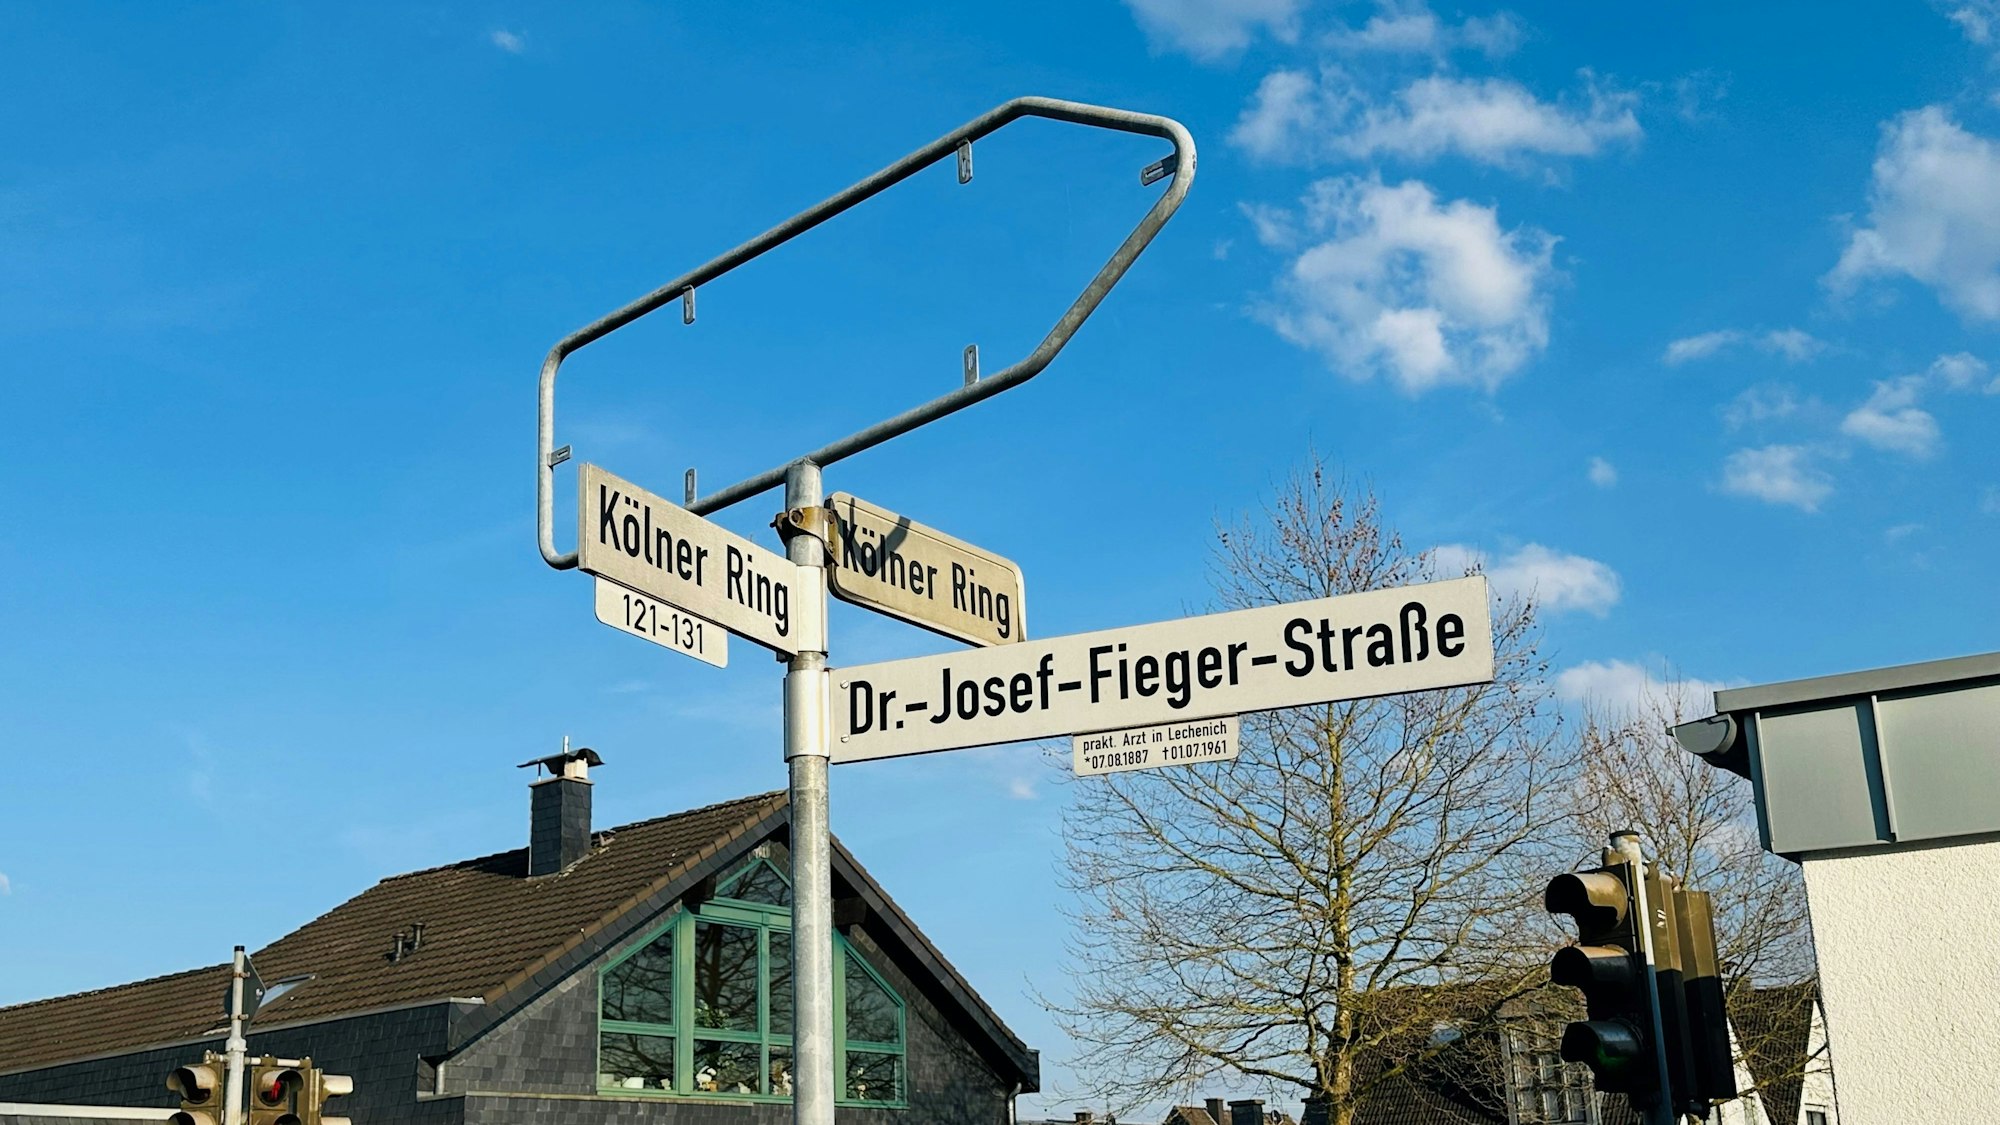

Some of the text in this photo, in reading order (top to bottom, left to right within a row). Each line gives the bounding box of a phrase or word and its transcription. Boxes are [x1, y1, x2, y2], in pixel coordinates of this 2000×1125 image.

[600, 484, 789, 637] Kölner Ring
[842, 519, 1010, 639] Kölner Ring
[623, 594, 703, 654] 121-131
[849, 601, 1466, 736] Dr.-Josef-Fieger-Straße
[1083, 720, 1227, 755] prakt. Arzt in Lechenich
